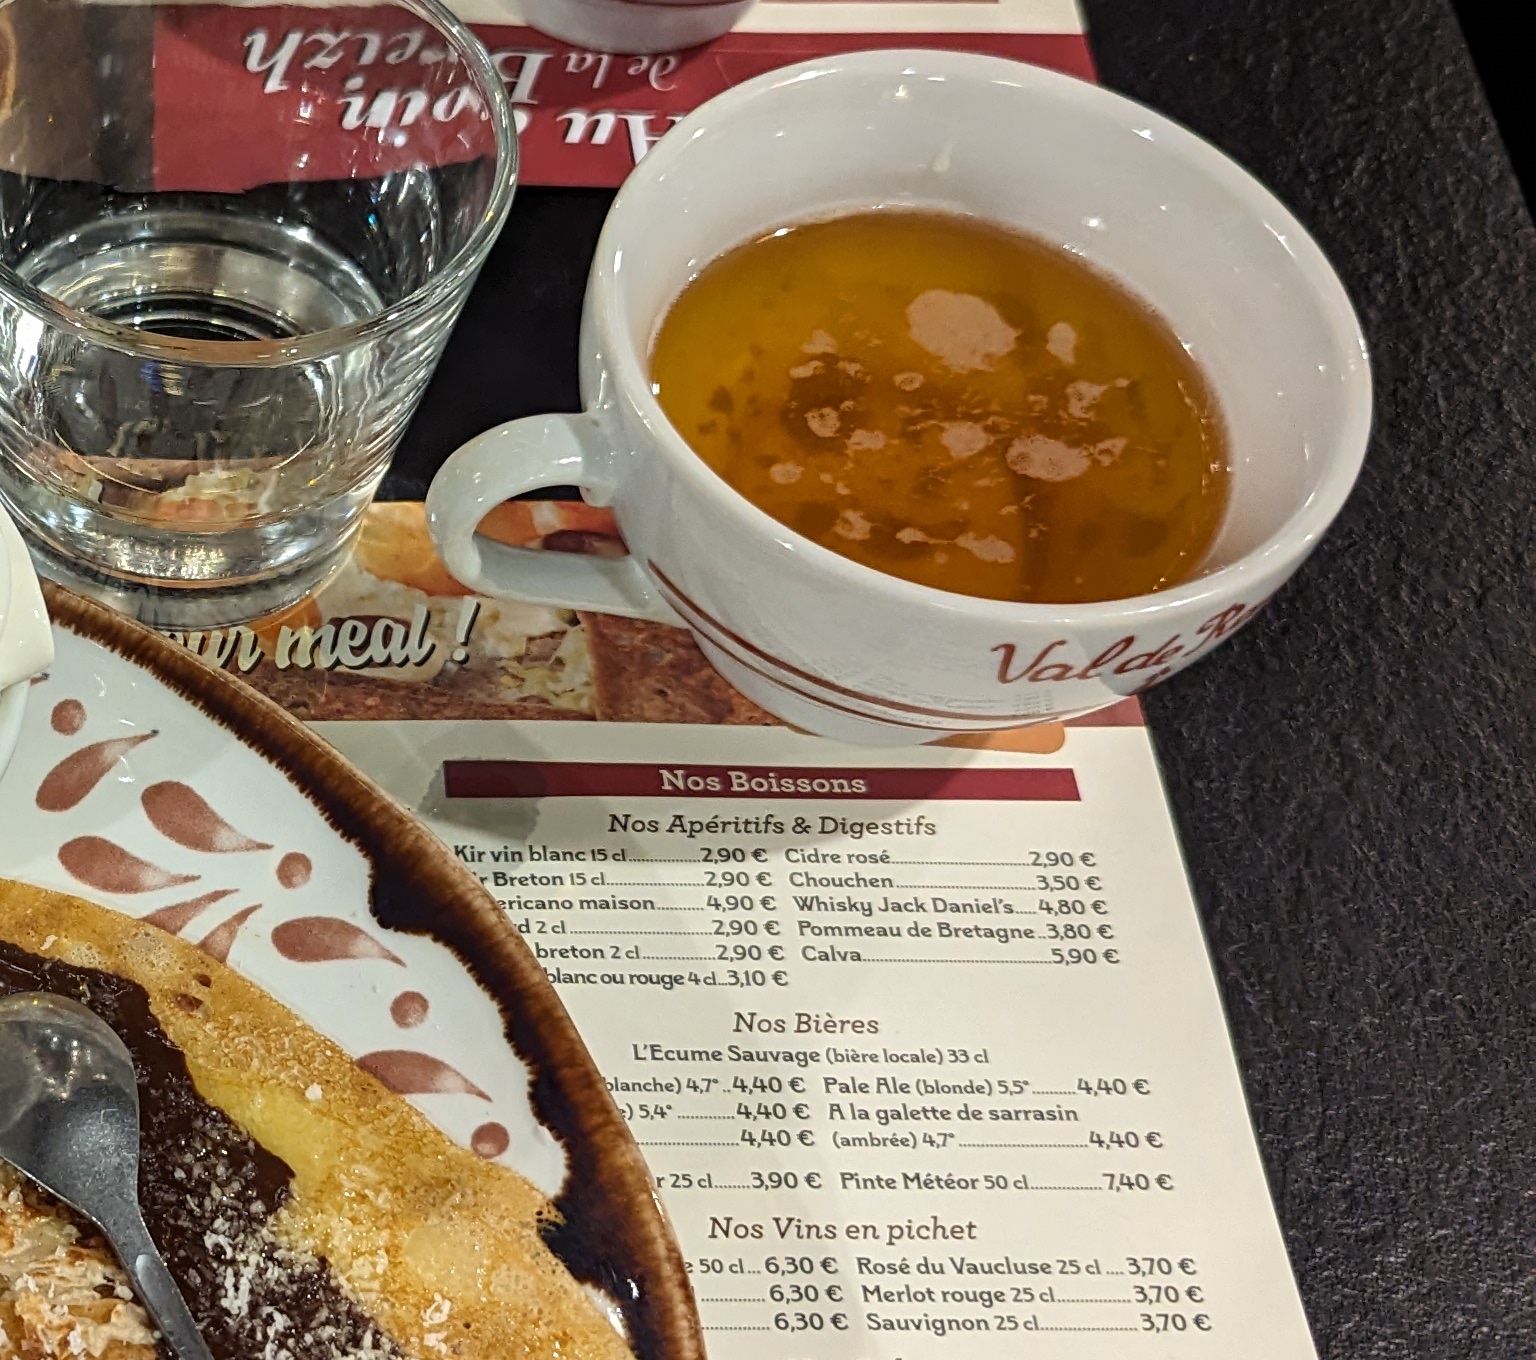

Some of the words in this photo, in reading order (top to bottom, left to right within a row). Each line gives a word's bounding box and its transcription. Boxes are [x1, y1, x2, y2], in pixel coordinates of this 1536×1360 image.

[276, 604, 436, 670] meal
[990, 635, 1136, 685] Val
[1113, 634, 1186, 676] de
[658, 769, 722, 792] Nos
[727, 770, 868, 794] Boissons
[607, 813, 660, 834] Nos
[665, 813, 785, 839] Apéritifs
[791, 816, 812, 835] &
[817, 814, 937, 840] Digestifs
[784, 847, 842, 864] Cidre
[846, 849, 891, 864] rosé
[1028, 850, 1074, 867] 2,90
[1078, 851, 1097, 868] €
[788, 870, 894, 888] Chouchen
[1035, 874, 1080, 893] 3,50
[1084, 875, 1103, 892] €
[791, 894, 873, 918] Whisky
[878, 896, 928, 913] Jack
[930, 897, 1015, 914] Daniel's
[1038, 898, 1086, 916] 4,80
[1089, 899, 1109, 916] €
[796, 920, 902, 938] Pommeau
[906, 920, 933, 938] de
[936, 921, 1036, 944] Bretagne
[1045, 923, 1092, 940] 3,80
[1096, 923, 1115, 940] €
[801, 944, 862, 962] Calva
[1050, 948, 1098, 965] 5,90
[1102, 948, 1121, 965] €
[732, 1011, 786, 1034] Nos
[793, 1012, 879, 1034] Bières
[632, 1043, 723, 1062] L'Ecume
[727, 1044, 821, 1068] Sauvage
[825, 1046, 880, 1066] (bière
[882, 1047, 944, 1066] locale)
[947, 1048, 970, 1064] 33
[973, 1048, 990, 1064] cl
[839, 1171, 897, 1190] Pinte
[901, 1172, 980, 1190] Météor
[983, 1174, 1008, 1190] 50
[1012, 1174, 1030, 1190] cl
[1102, 1172, 1150, 1191] 7,40
[1154, 1173, 1174, 1191] €
[707, 1216, 764, 1240] Nos
[772, 1216, 837, 1240] Vins
[845, 1224, 880, 1240] en
[885, 1215, 977, 1246] pichet
[856, 1256, 911, 1275] Rosé
[916, 1256, 946, 1275] du
[948, 1255, 1052, 1275] Vaucluse
[1055, 1259, 1082, 1275] 25
[1084, 1258, 1102, 1275] cl
[1125, 1256, 1173, 1276] 3,70
[1177, 1257, 1198, 1276] €
